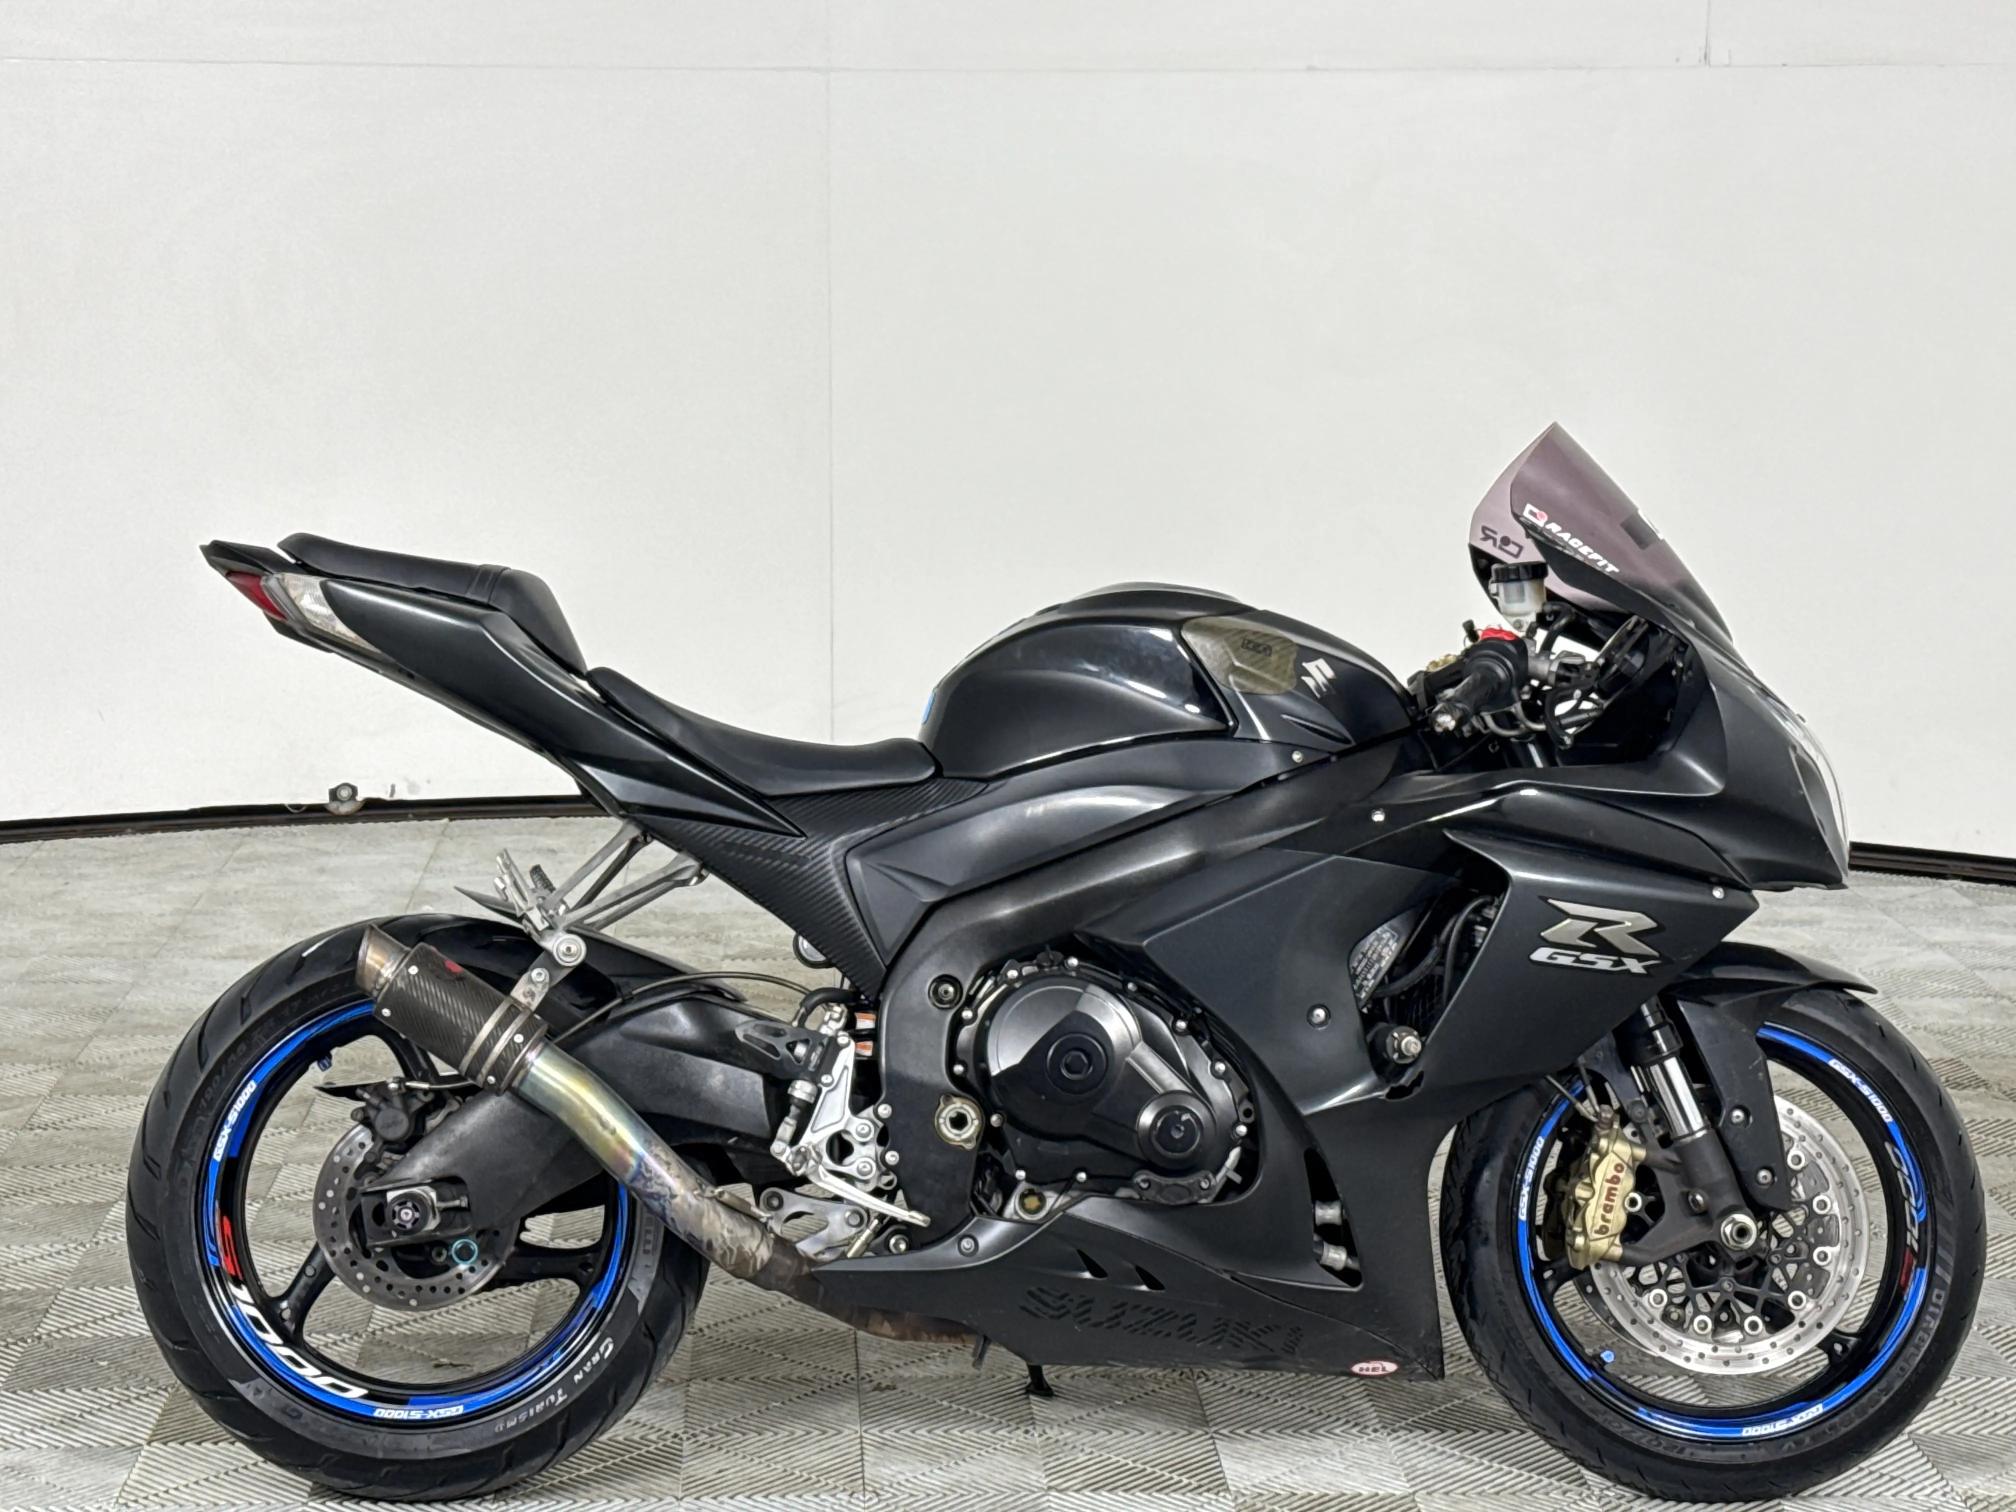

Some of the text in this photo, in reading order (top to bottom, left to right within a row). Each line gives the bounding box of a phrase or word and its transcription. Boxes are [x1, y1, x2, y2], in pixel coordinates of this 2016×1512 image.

[1545, 522, 1620, 573] RACEFIT
[1529, 947, 1662, 974] GSX
[1828, 1058, 1894, 1123] GSX-S1000
[212, 1079, 258, 1162] GSX-S1000
[1518, 1135, 1545, 1222] GSX-S1000
[1594, 1162, 1625, 1236] brembo
[373, 1404, 464, 1420] GSX-S1000
[1742, 1402, 1824, 1437] GSX-S1000
